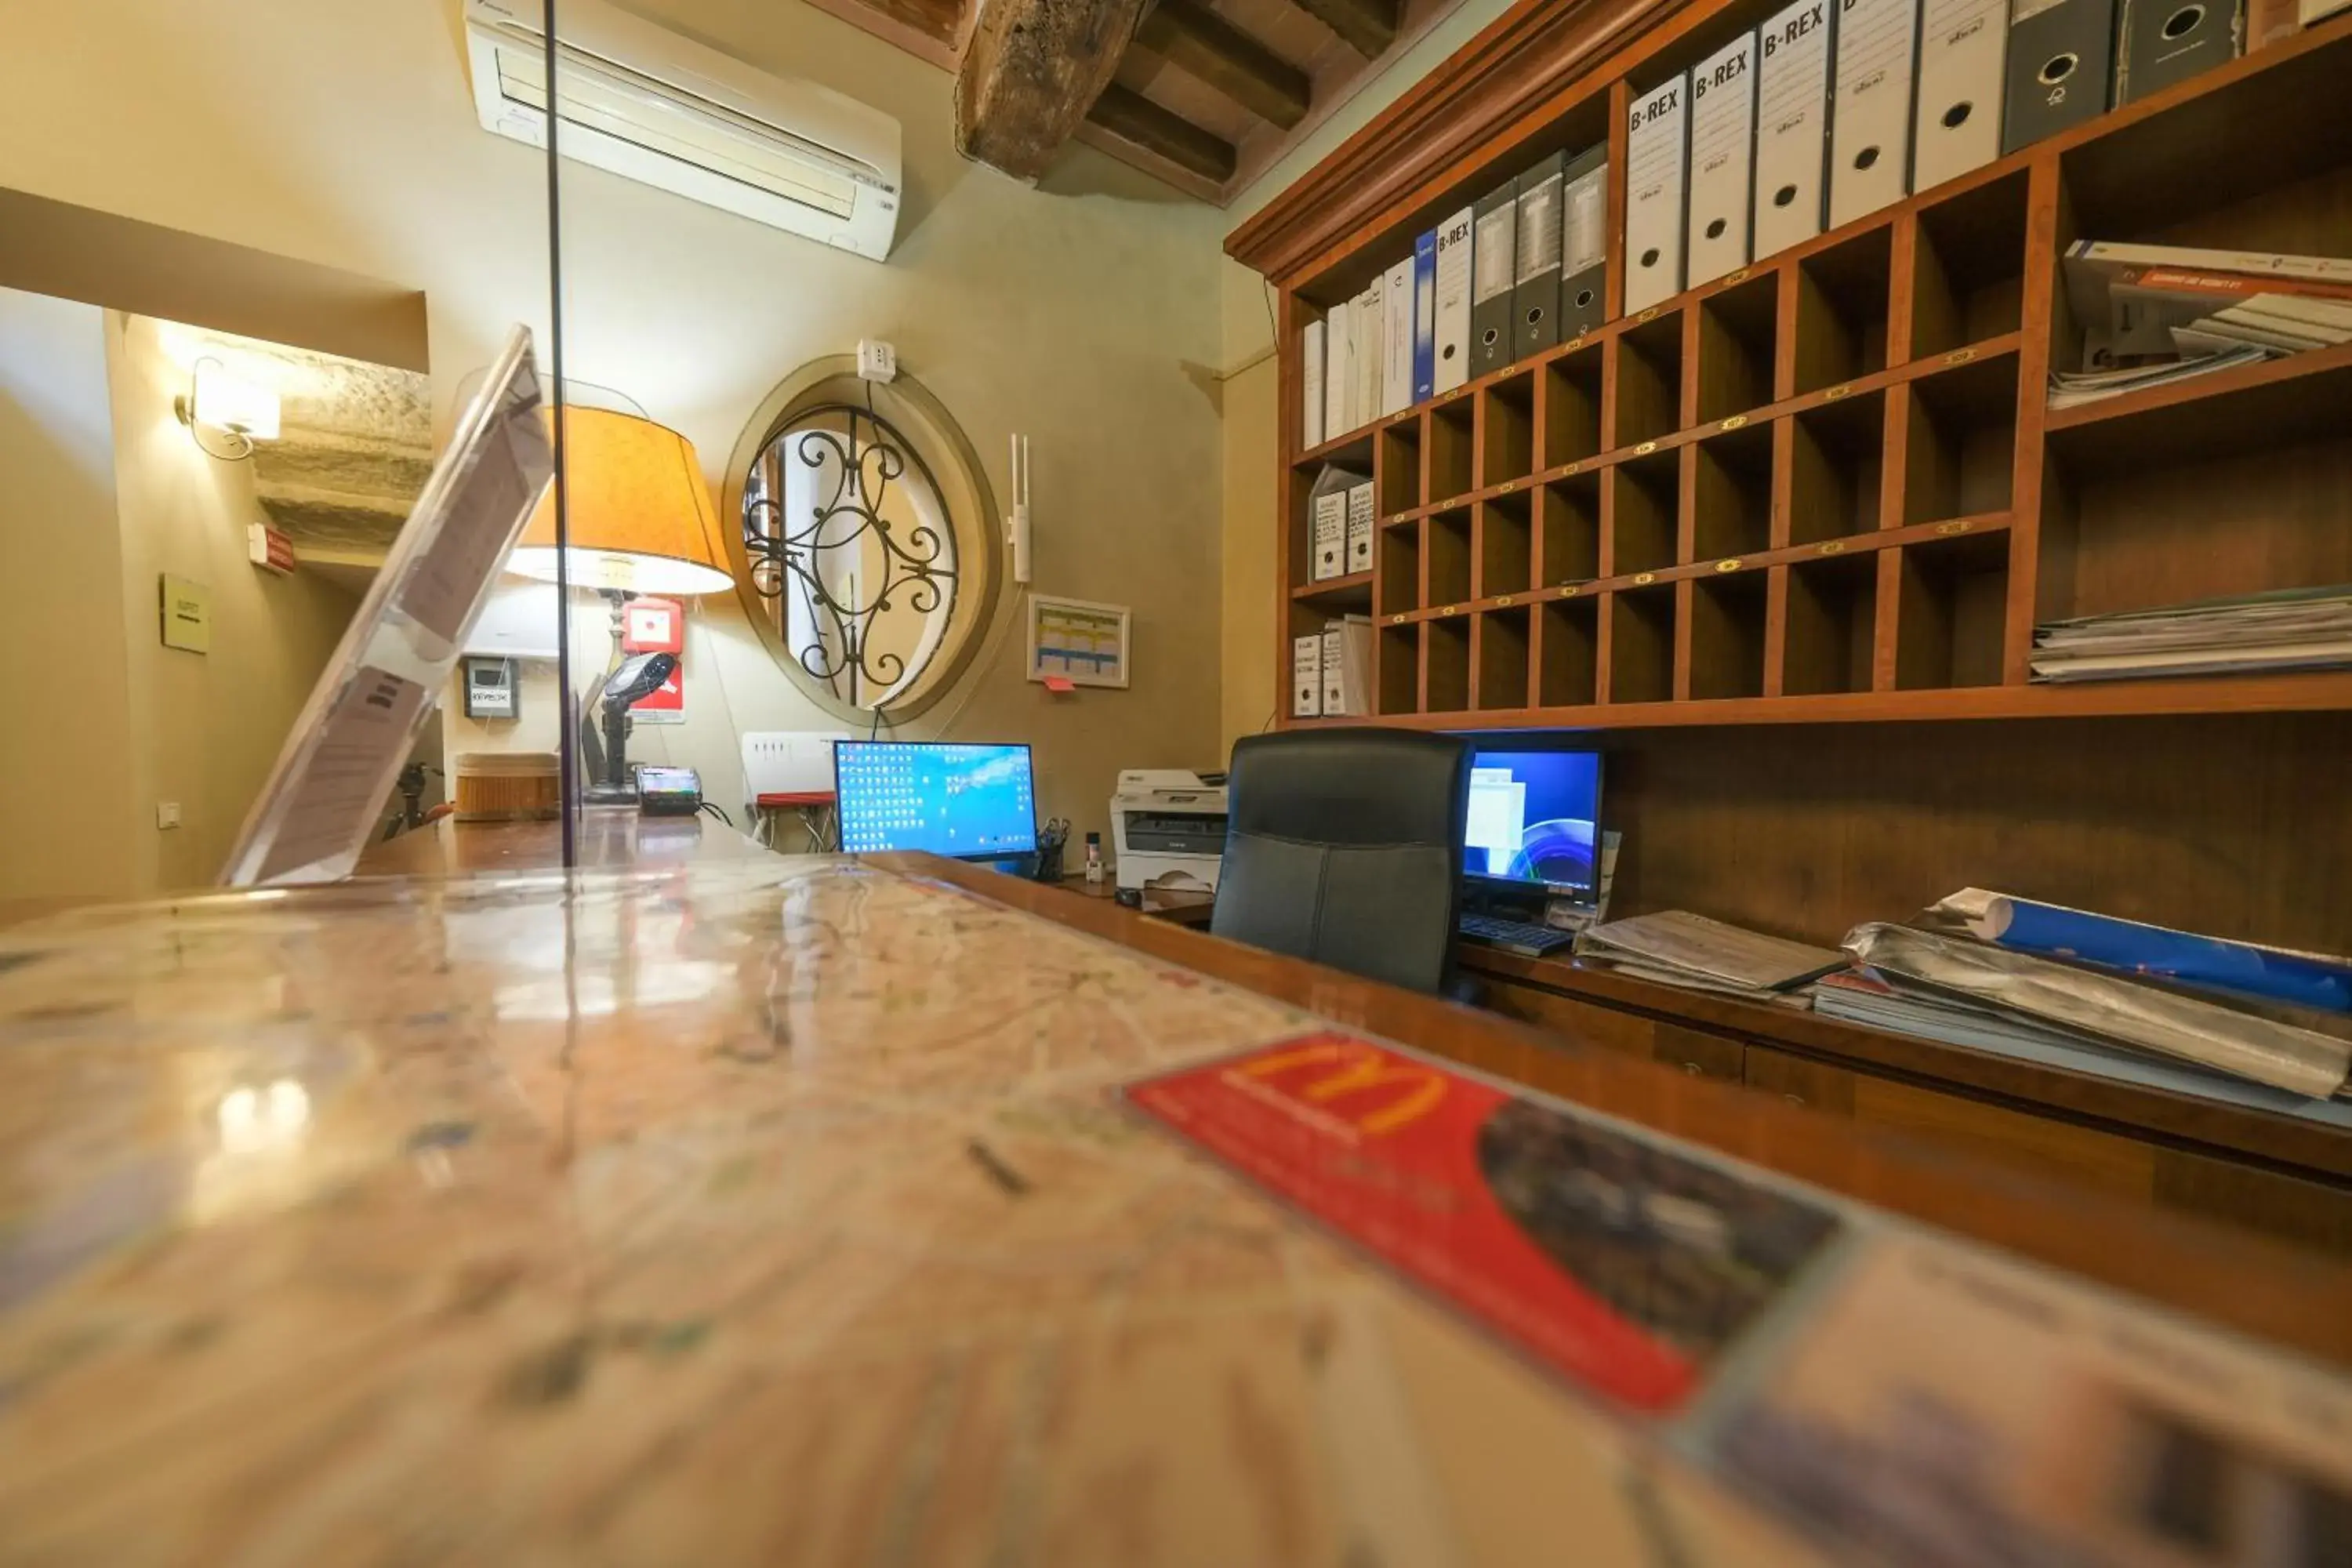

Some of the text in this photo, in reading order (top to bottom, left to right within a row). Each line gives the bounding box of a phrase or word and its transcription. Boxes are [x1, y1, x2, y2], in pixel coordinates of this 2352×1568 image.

[1766, 2, 1823, 59] B-REX
[1696, 49, 1747, 100] B-REX
[1631, 89, 1678, 132] B-REX
[1439, 221, 1468, 252] B-REX
